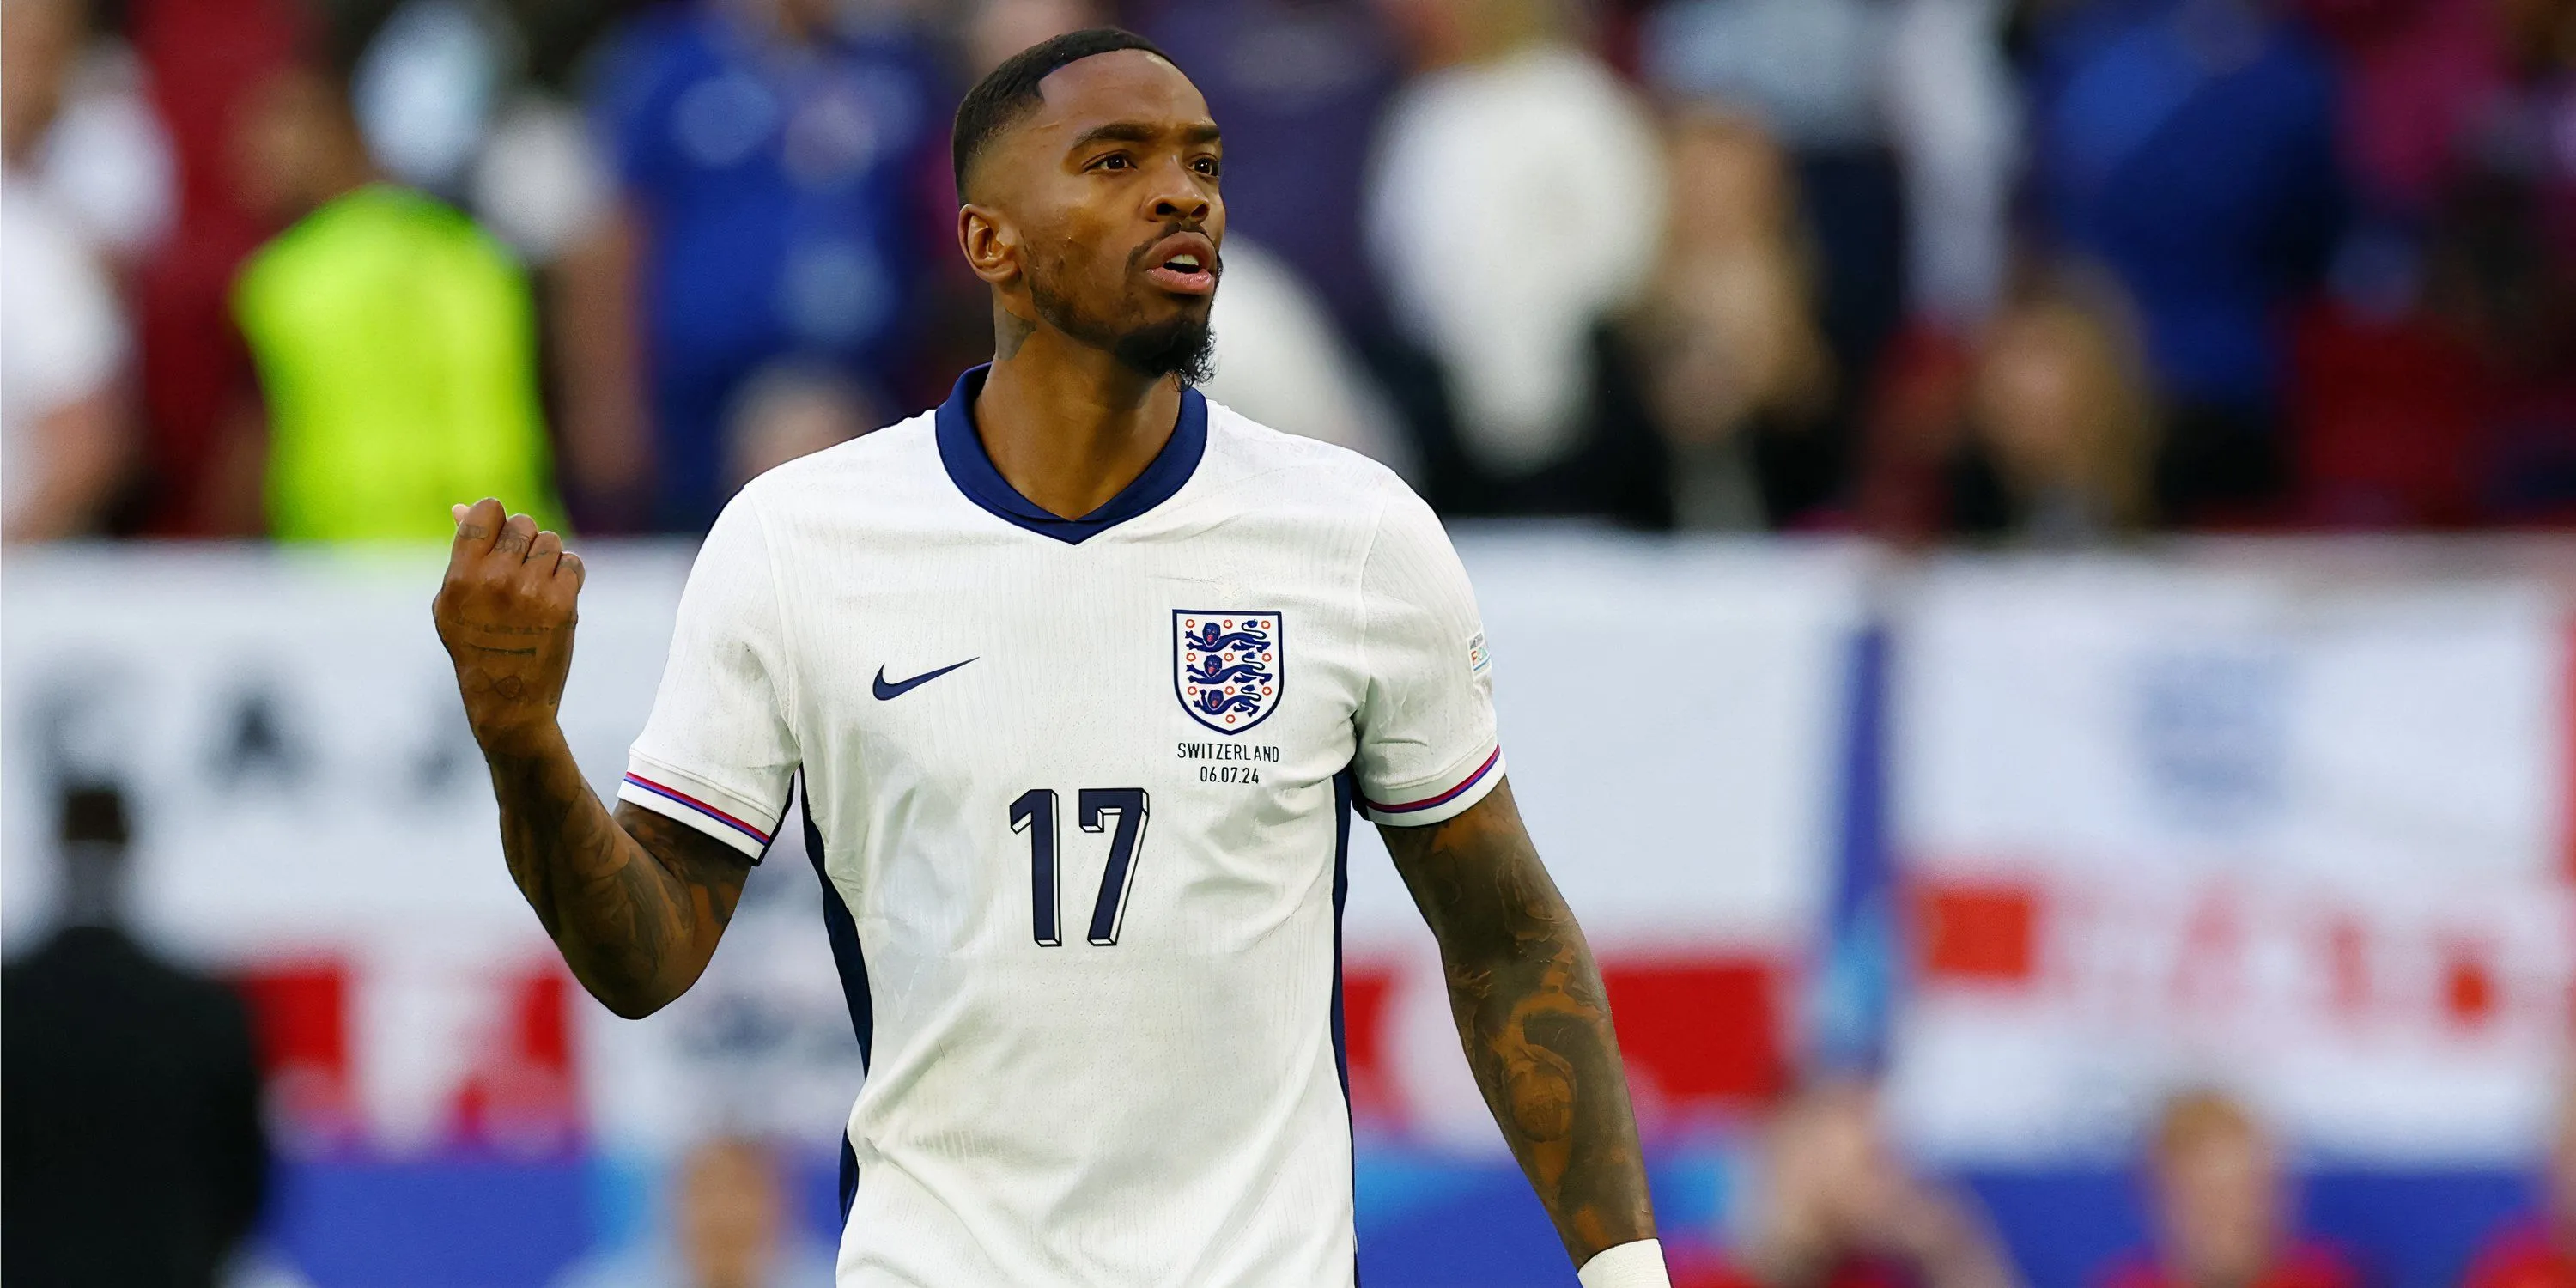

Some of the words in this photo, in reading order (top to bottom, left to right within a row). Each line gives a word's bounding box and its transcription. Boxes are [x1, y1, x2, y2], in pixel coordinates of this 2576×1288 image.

[1177, 742, 1279, 762] SWITZERLAND
[1200, 766, 1260, 784] 06.07.24
[1009, 787, 1149, 947] 17
